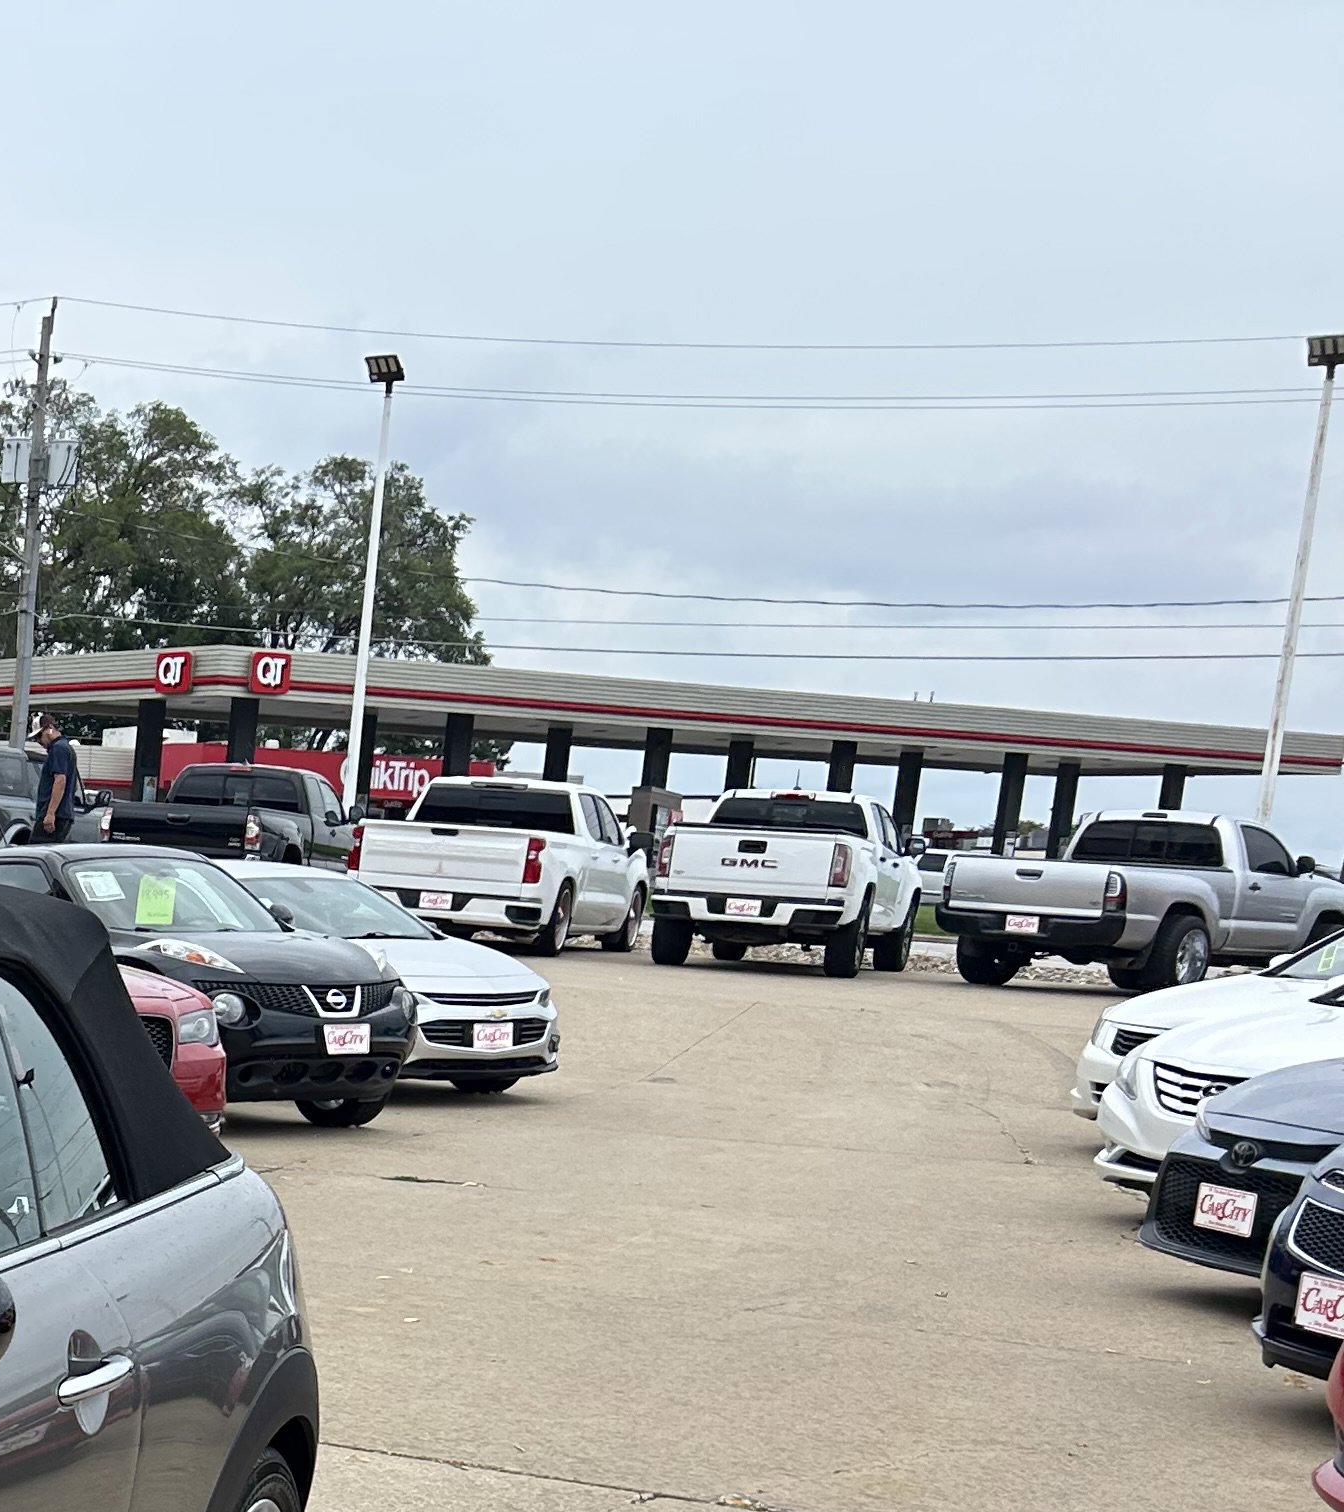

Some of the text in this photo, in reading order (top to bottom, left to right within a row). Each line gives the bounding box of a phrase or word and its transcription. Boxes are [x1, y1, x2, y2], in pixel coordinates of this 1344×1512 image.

[158, 656, 186, 686] QT
[257, 656, 286, 687] QT
[720, 857, 779, 869] GMC
